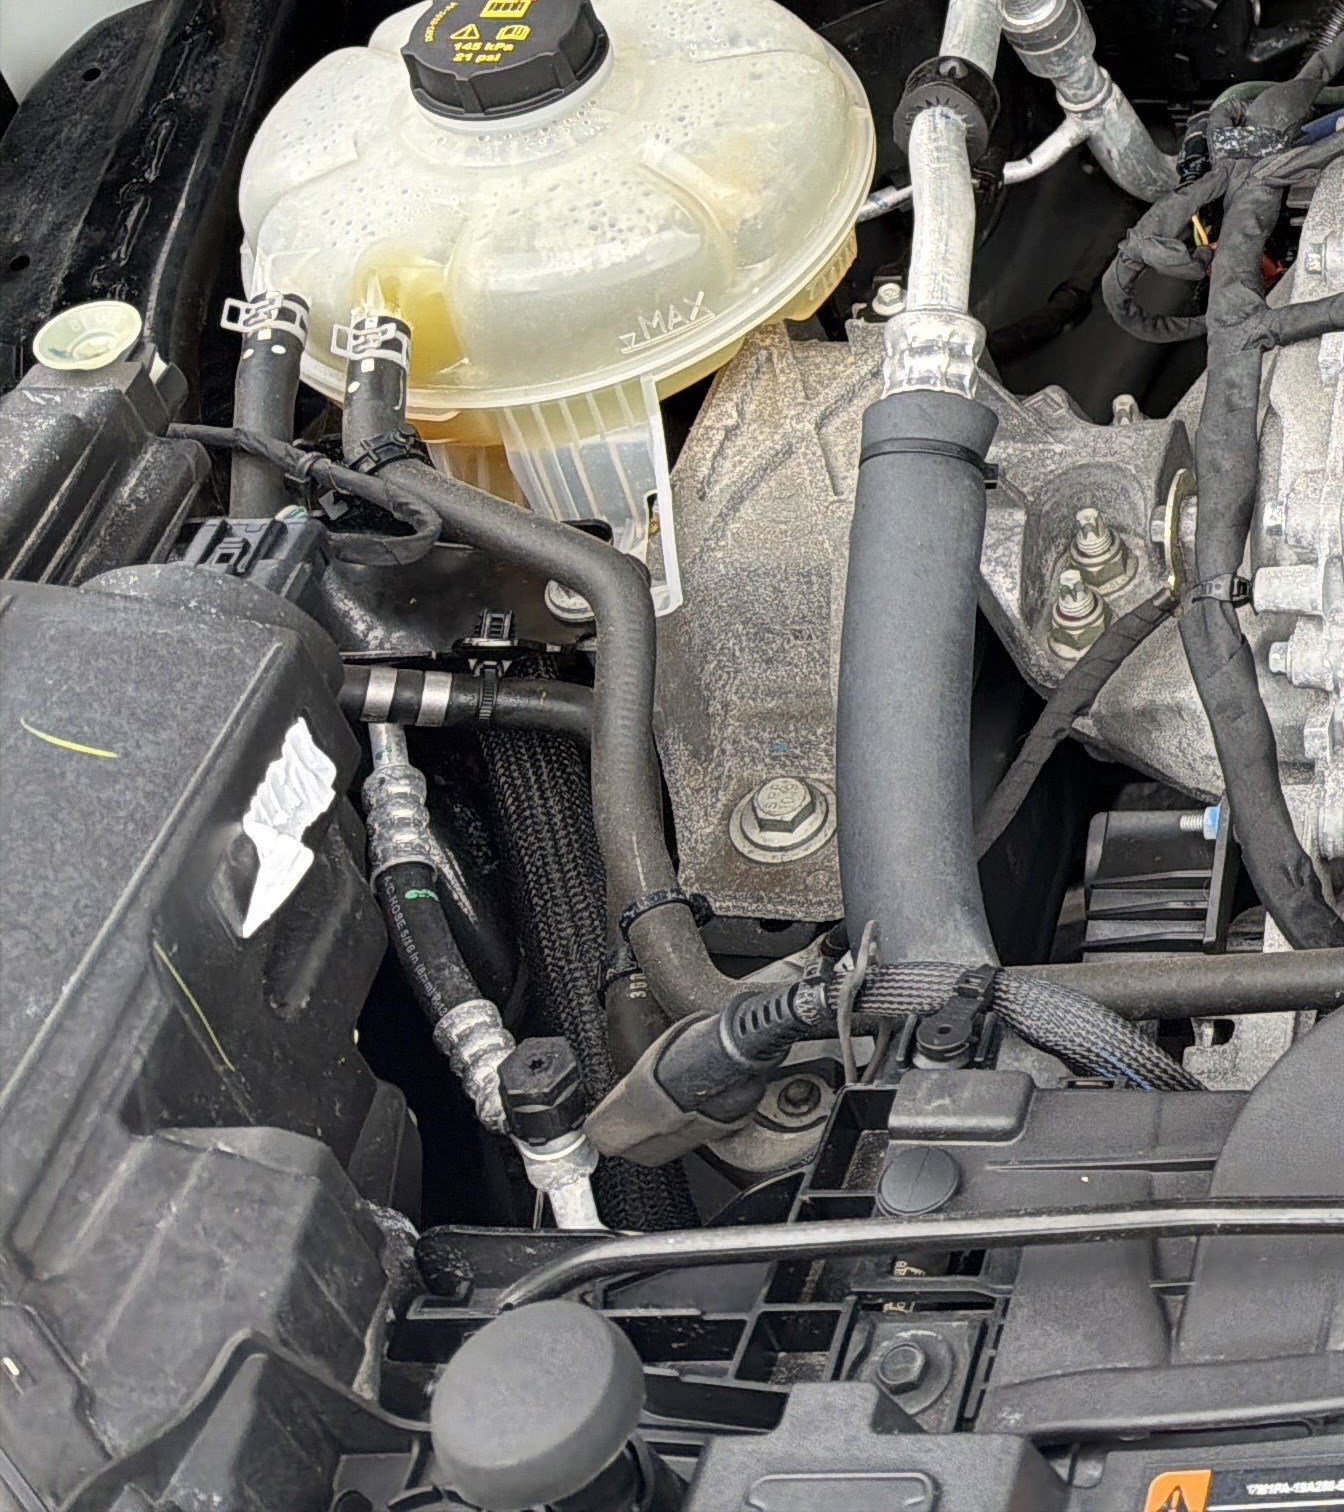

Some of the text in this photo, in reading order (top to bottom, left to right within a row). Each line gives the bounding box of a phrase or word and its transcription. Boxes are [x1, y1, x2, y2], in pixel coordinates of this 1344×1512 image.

[452, 52, 502, 64] 21 psi
[453, 42, 515, 52] 145 kPa
[638, 290, 716, 340] MAX
[388, 895, 407, 931] HOSE
